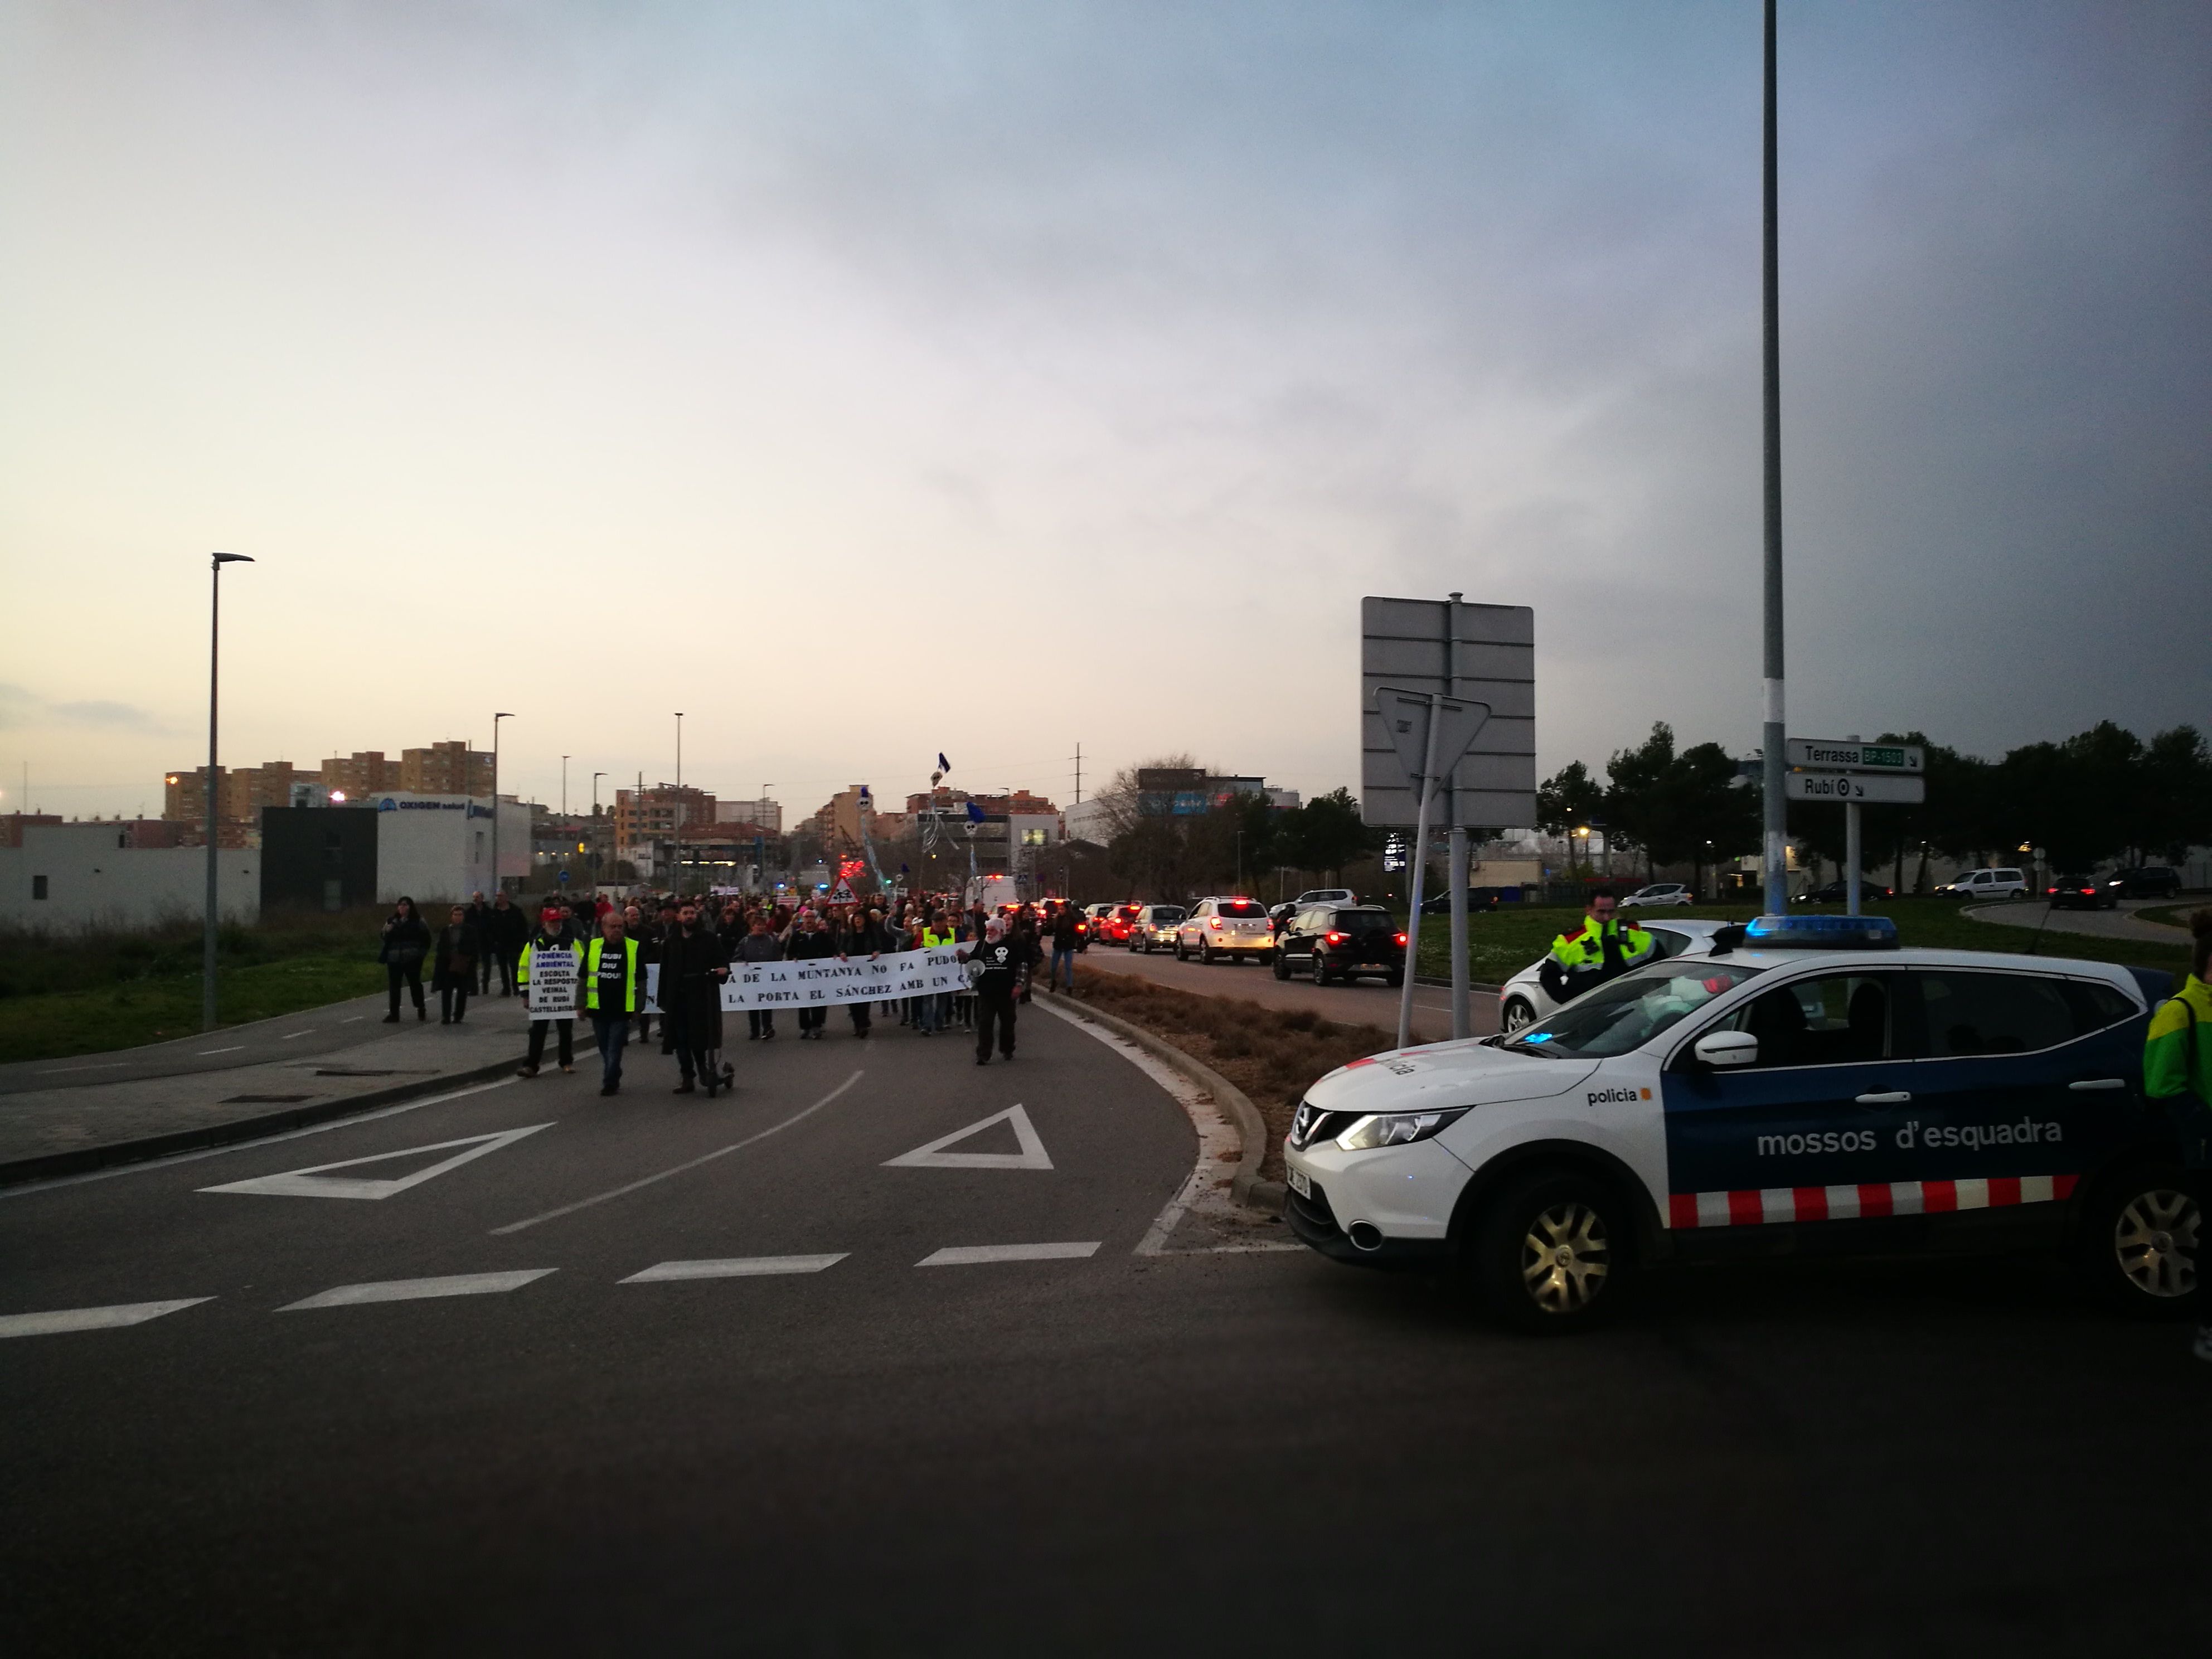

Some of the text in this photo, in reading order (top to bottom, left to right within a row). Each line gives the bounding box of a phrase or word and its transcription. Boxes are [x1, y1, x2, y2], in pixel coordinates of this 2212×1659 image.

[1806, 745, 1903, 764] Terrassa BP-1503
[1805, 778, 1835, 794] Rubí
[744, 973, 760, 983] DE
[772, 971, 788, 982] LA
[798, 966, 862, 981] MUNTANYA
[871, 964, 887, 974] NO
[900, 962, 914, 972] FA
[927, 955, 957, 967] PUDO
[729, 993, 745, 1004] LA
[758, 990, 800, 1003] PORTA
[811, 990, 825, 1000] EL
[836, 984, 892, 998] SÁNCHEZ
[900, 979, 924, 991] AMB
[933, 976, 949, 987] UN
[958, 974, 971, 983] CA
[1588, 1088, 1637, 1107] policia
[1757, 1115, 2063, 1156] mossos d'esquadra
